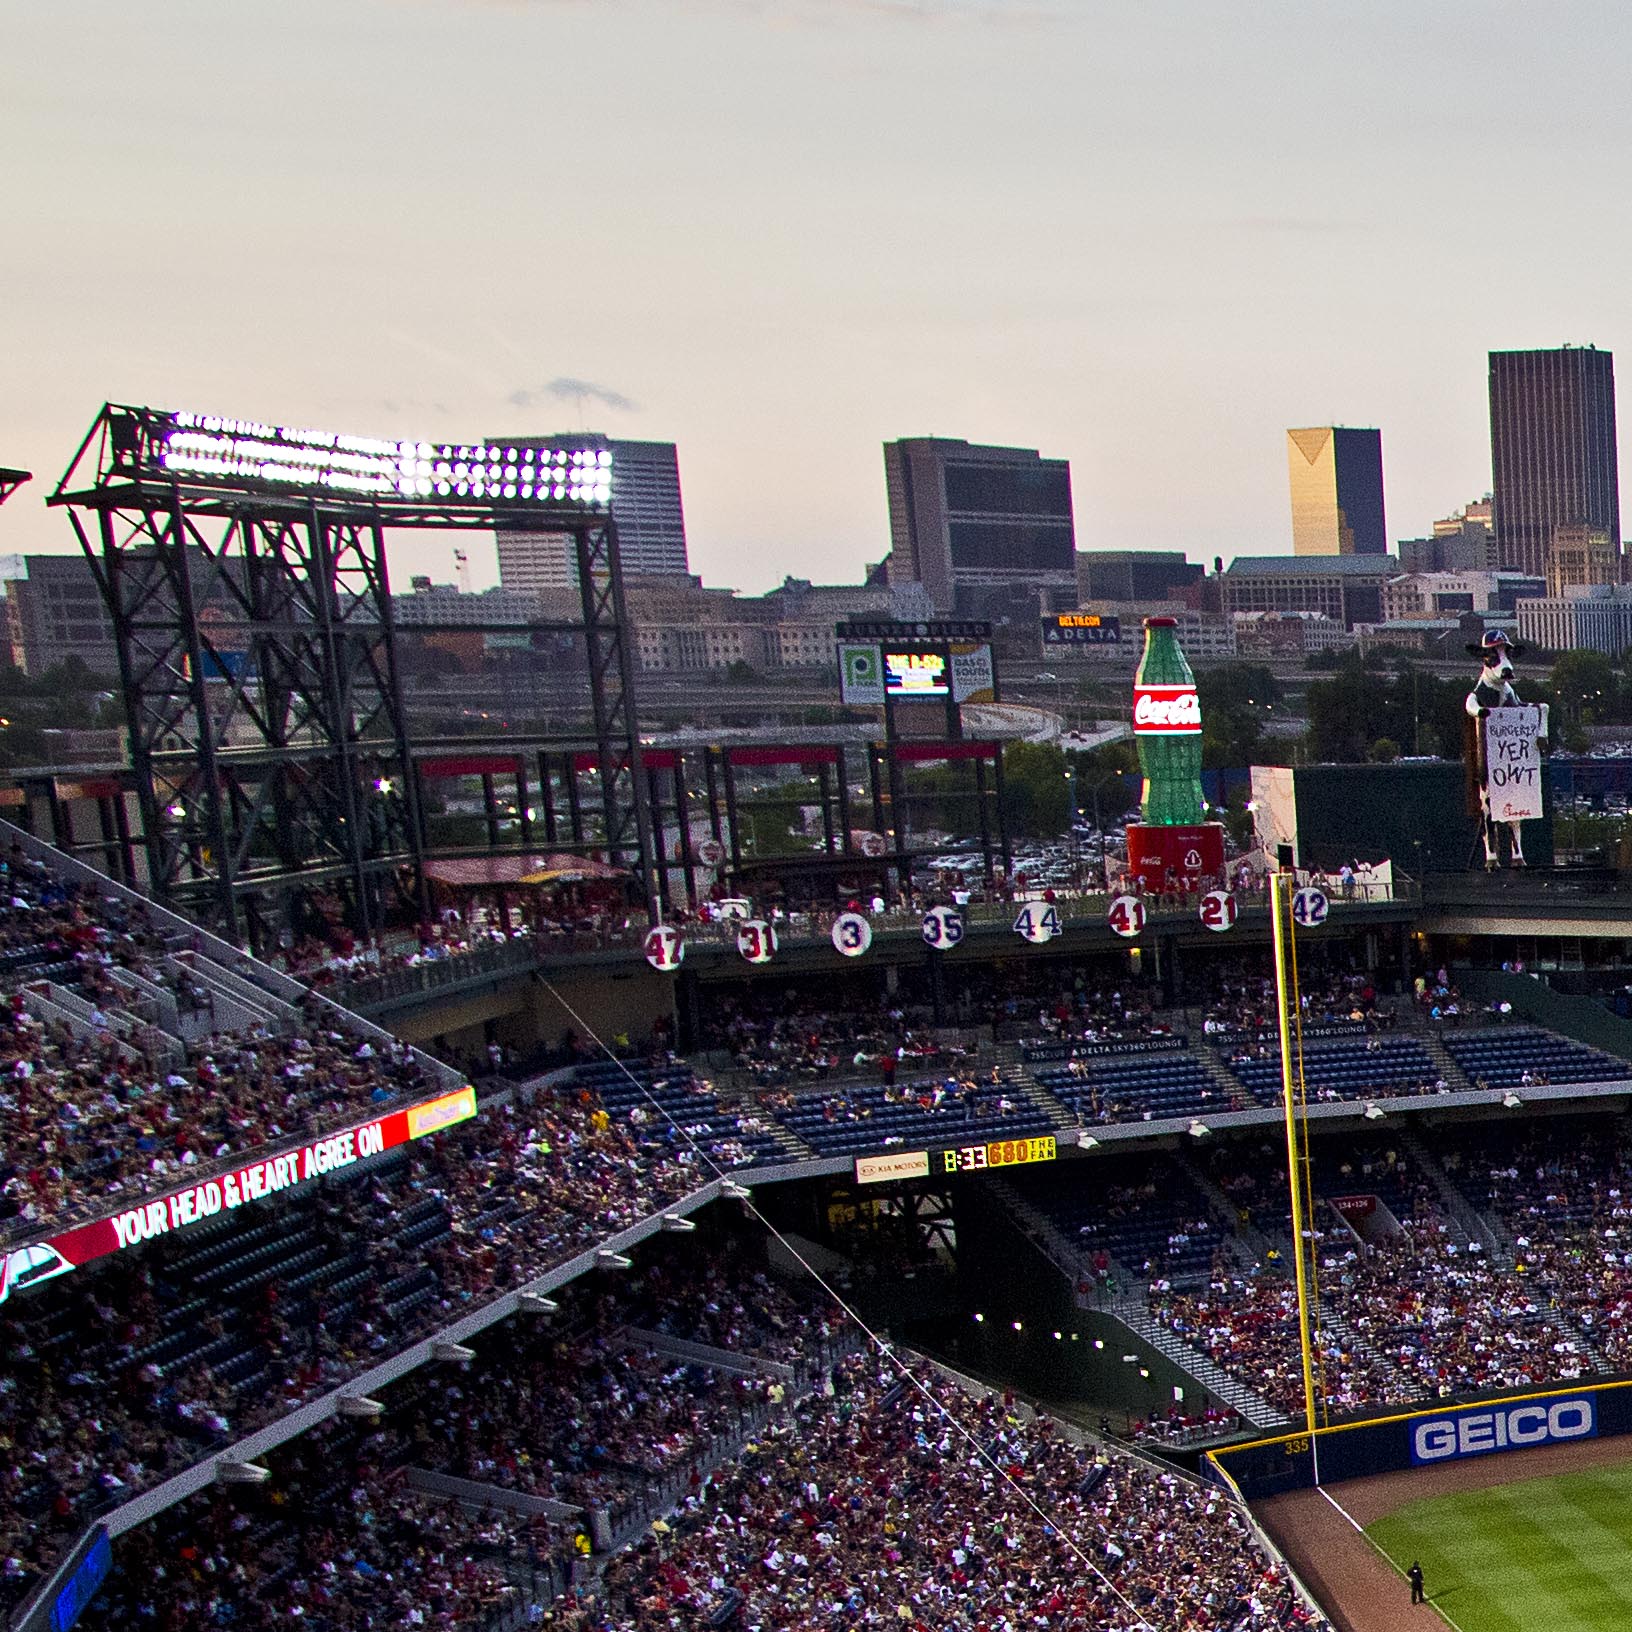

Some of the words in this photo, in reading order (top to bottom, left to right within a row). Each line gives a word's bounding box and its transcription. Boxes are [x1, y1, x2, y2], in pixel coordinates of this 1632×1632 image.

[1064, 629, 1117, 640] DELTA
[1498, 739, 1529, 761] YER
[1493, 764, 1537, 787] OWT
[1014, 905, 1062, 936] 44
[1109, 903, 1144, 932] 41
[1201, 897, 1236, 925] 21
[1293, 894, 1327, 923] 42
[740, 926, 775, 958] 31
[841, 920, 863, 948] 3
[922, 915, 962, 943] 35
[648, 930, 685, 965] 47
[1081, 1045, 1110, 1055] DELTA
[990, 1141, 1028, 1164] 680
[1030, 1137, 1054, 1149] THE
[1030, 1149, 1054, 1160] FAN
[878, 1165, 892, 1173] KIA
[894, 1161, 927, 1171] MOTORS
[944, 1145, 989, 1172] 8:33
[111, 1201, 168, 1248] YOUR
[169, 1182, 222, 1229] HEAD
[223, 1174, 243, 1209] &
[241, 1152, 299, 1203] HEART
[304, 1132, 357, 1180] AGREE
[357, 1122, 384, 1159] ON
[1414, 1400, 1592, 1459] GEICO
[1285, 1439, 1309, 1455] 335
